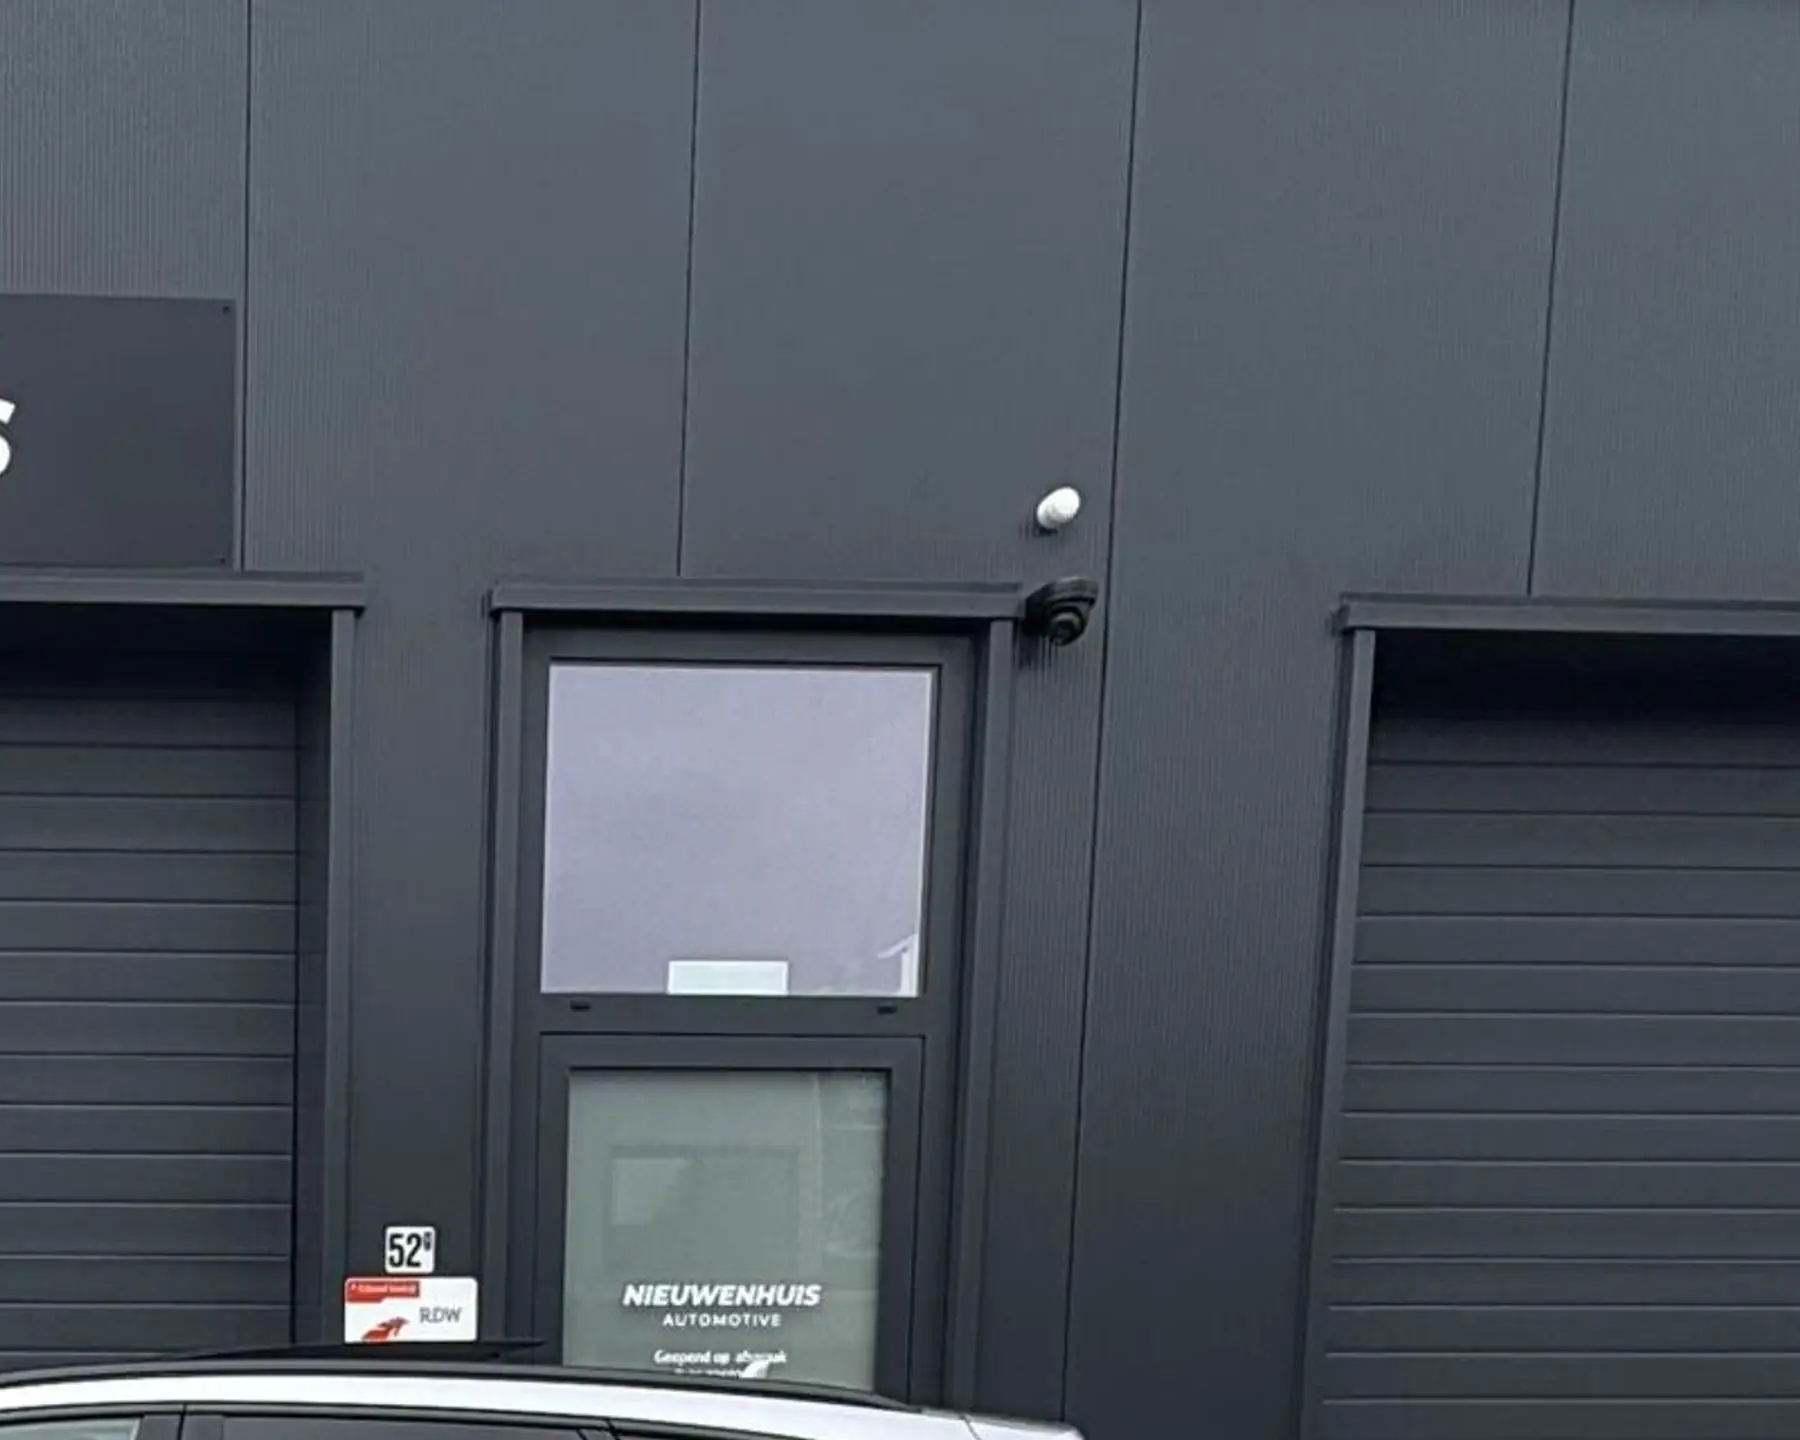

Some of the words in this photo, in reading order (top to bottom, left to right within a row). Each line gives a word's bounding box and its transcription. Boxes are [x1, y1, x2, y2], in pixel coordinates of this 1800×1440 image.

[622, 1283, 821, 1306] NIEUWENHUIS
[419, 1306, 462, 1323] RDW
[662, 1313, 782, 1327] AUTOMOTIVE
